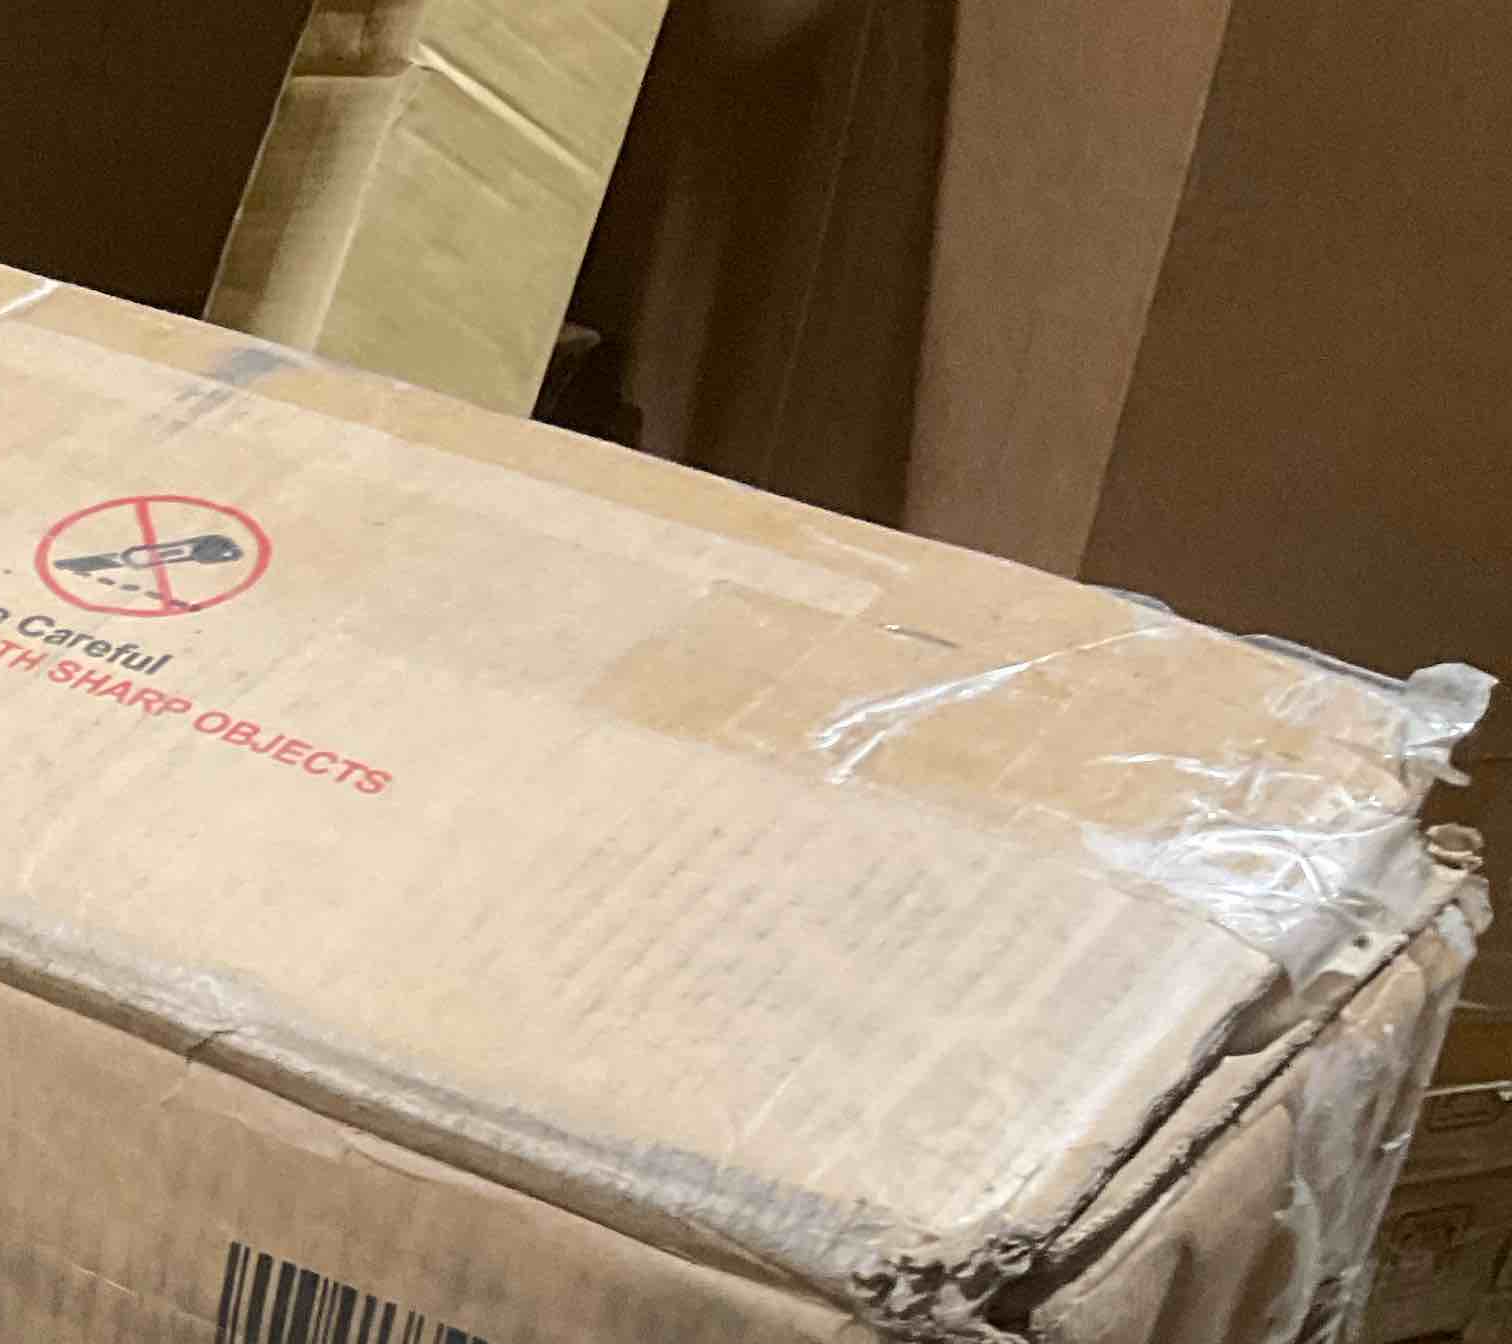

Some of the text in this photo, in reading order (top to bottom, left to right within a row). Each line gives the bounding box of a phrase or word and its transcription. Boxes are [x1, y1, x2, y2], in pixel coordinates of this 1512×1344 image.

[15, 613, 174, 677] Careful
[47, 658, 194, 721] SHARP
[192, 707, 394, 797] OBJECTS
